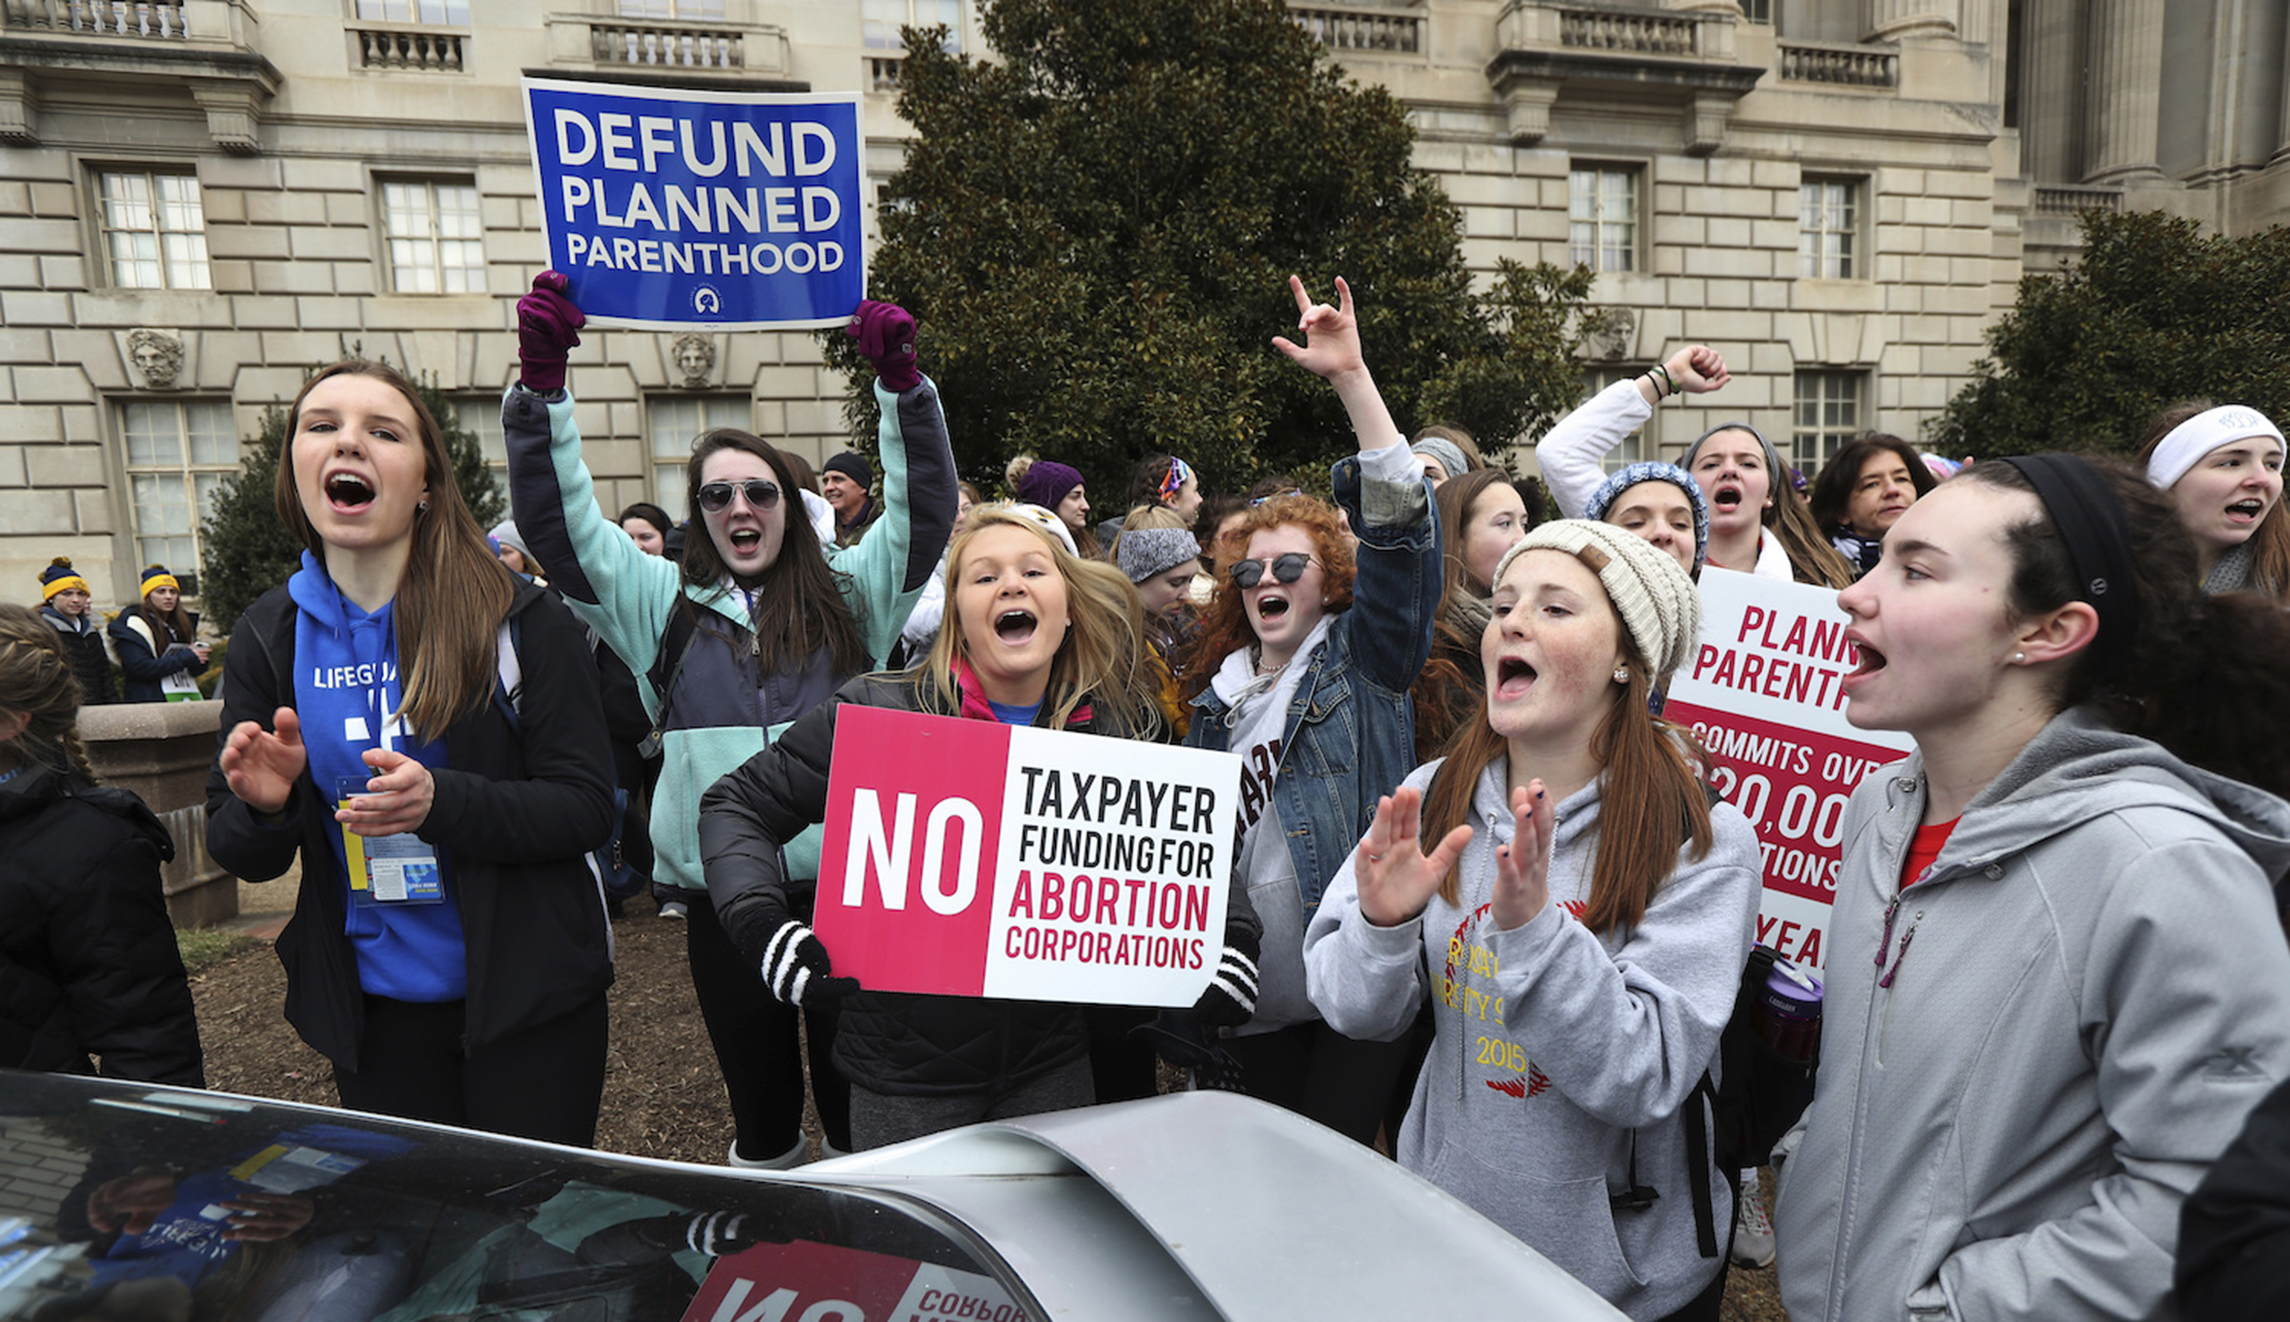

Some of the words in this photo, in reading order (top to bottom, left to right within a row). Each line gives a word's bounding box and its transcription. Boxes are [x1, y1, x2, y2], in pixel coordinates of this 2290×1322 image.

[554, 108, 837, 177] DEFUND
[561, 175, 841, 233] PLANNED
[567, 233, 844, 275] PARENTHOOD
[1690, 722, 1814, 775] COMMITS
[1021, 766, 1216, 834] TAXPAYER
[842, 787, 984, 915] NO
[1019, 824, 1155, 874] FUNDING
[1158, 838, 1213, 878] FOR
[1008, 870, 1210, 932] ABORTION
[1005, 926, 1204, 970] CORPORATIONS
[1476, 1036, 1526, 1073] 2015
